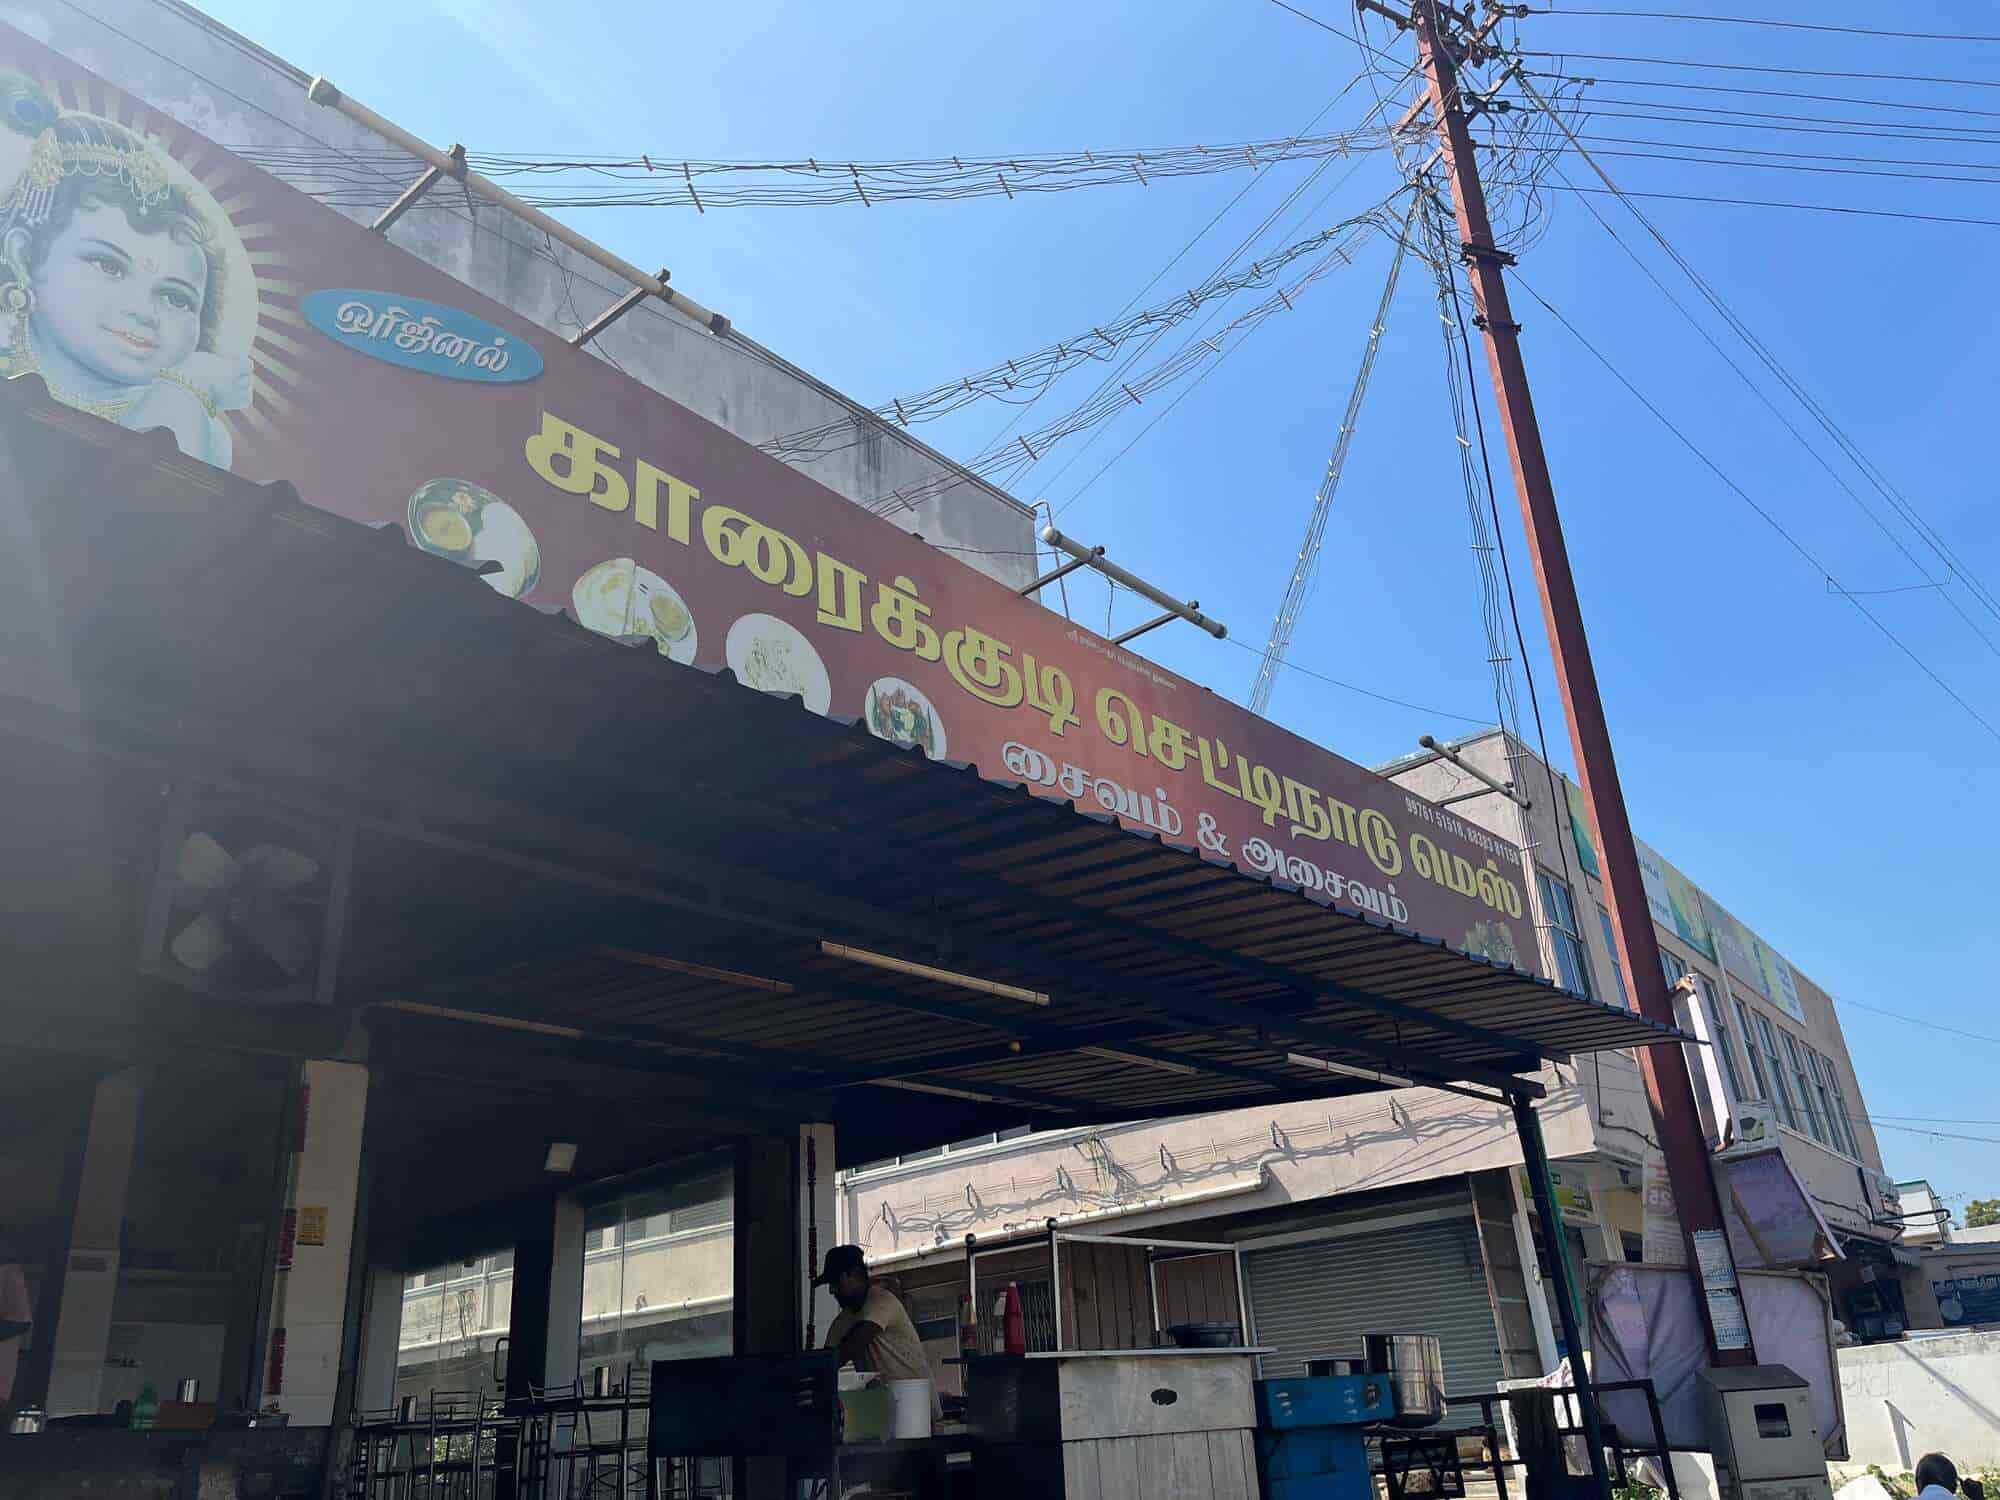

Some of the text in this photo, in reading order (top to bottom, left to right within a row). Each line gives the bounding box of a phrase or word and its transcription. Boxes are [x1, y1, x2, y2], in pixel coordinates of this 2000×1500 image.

[335, 301, 511, 373] ஒரிஜினல்
[525, 409, 1522, 919] காரைக்குடி செட்டிநாடு மெஸ்
[1002, 741, 1408, 924] சைவம் & அசைவம்
